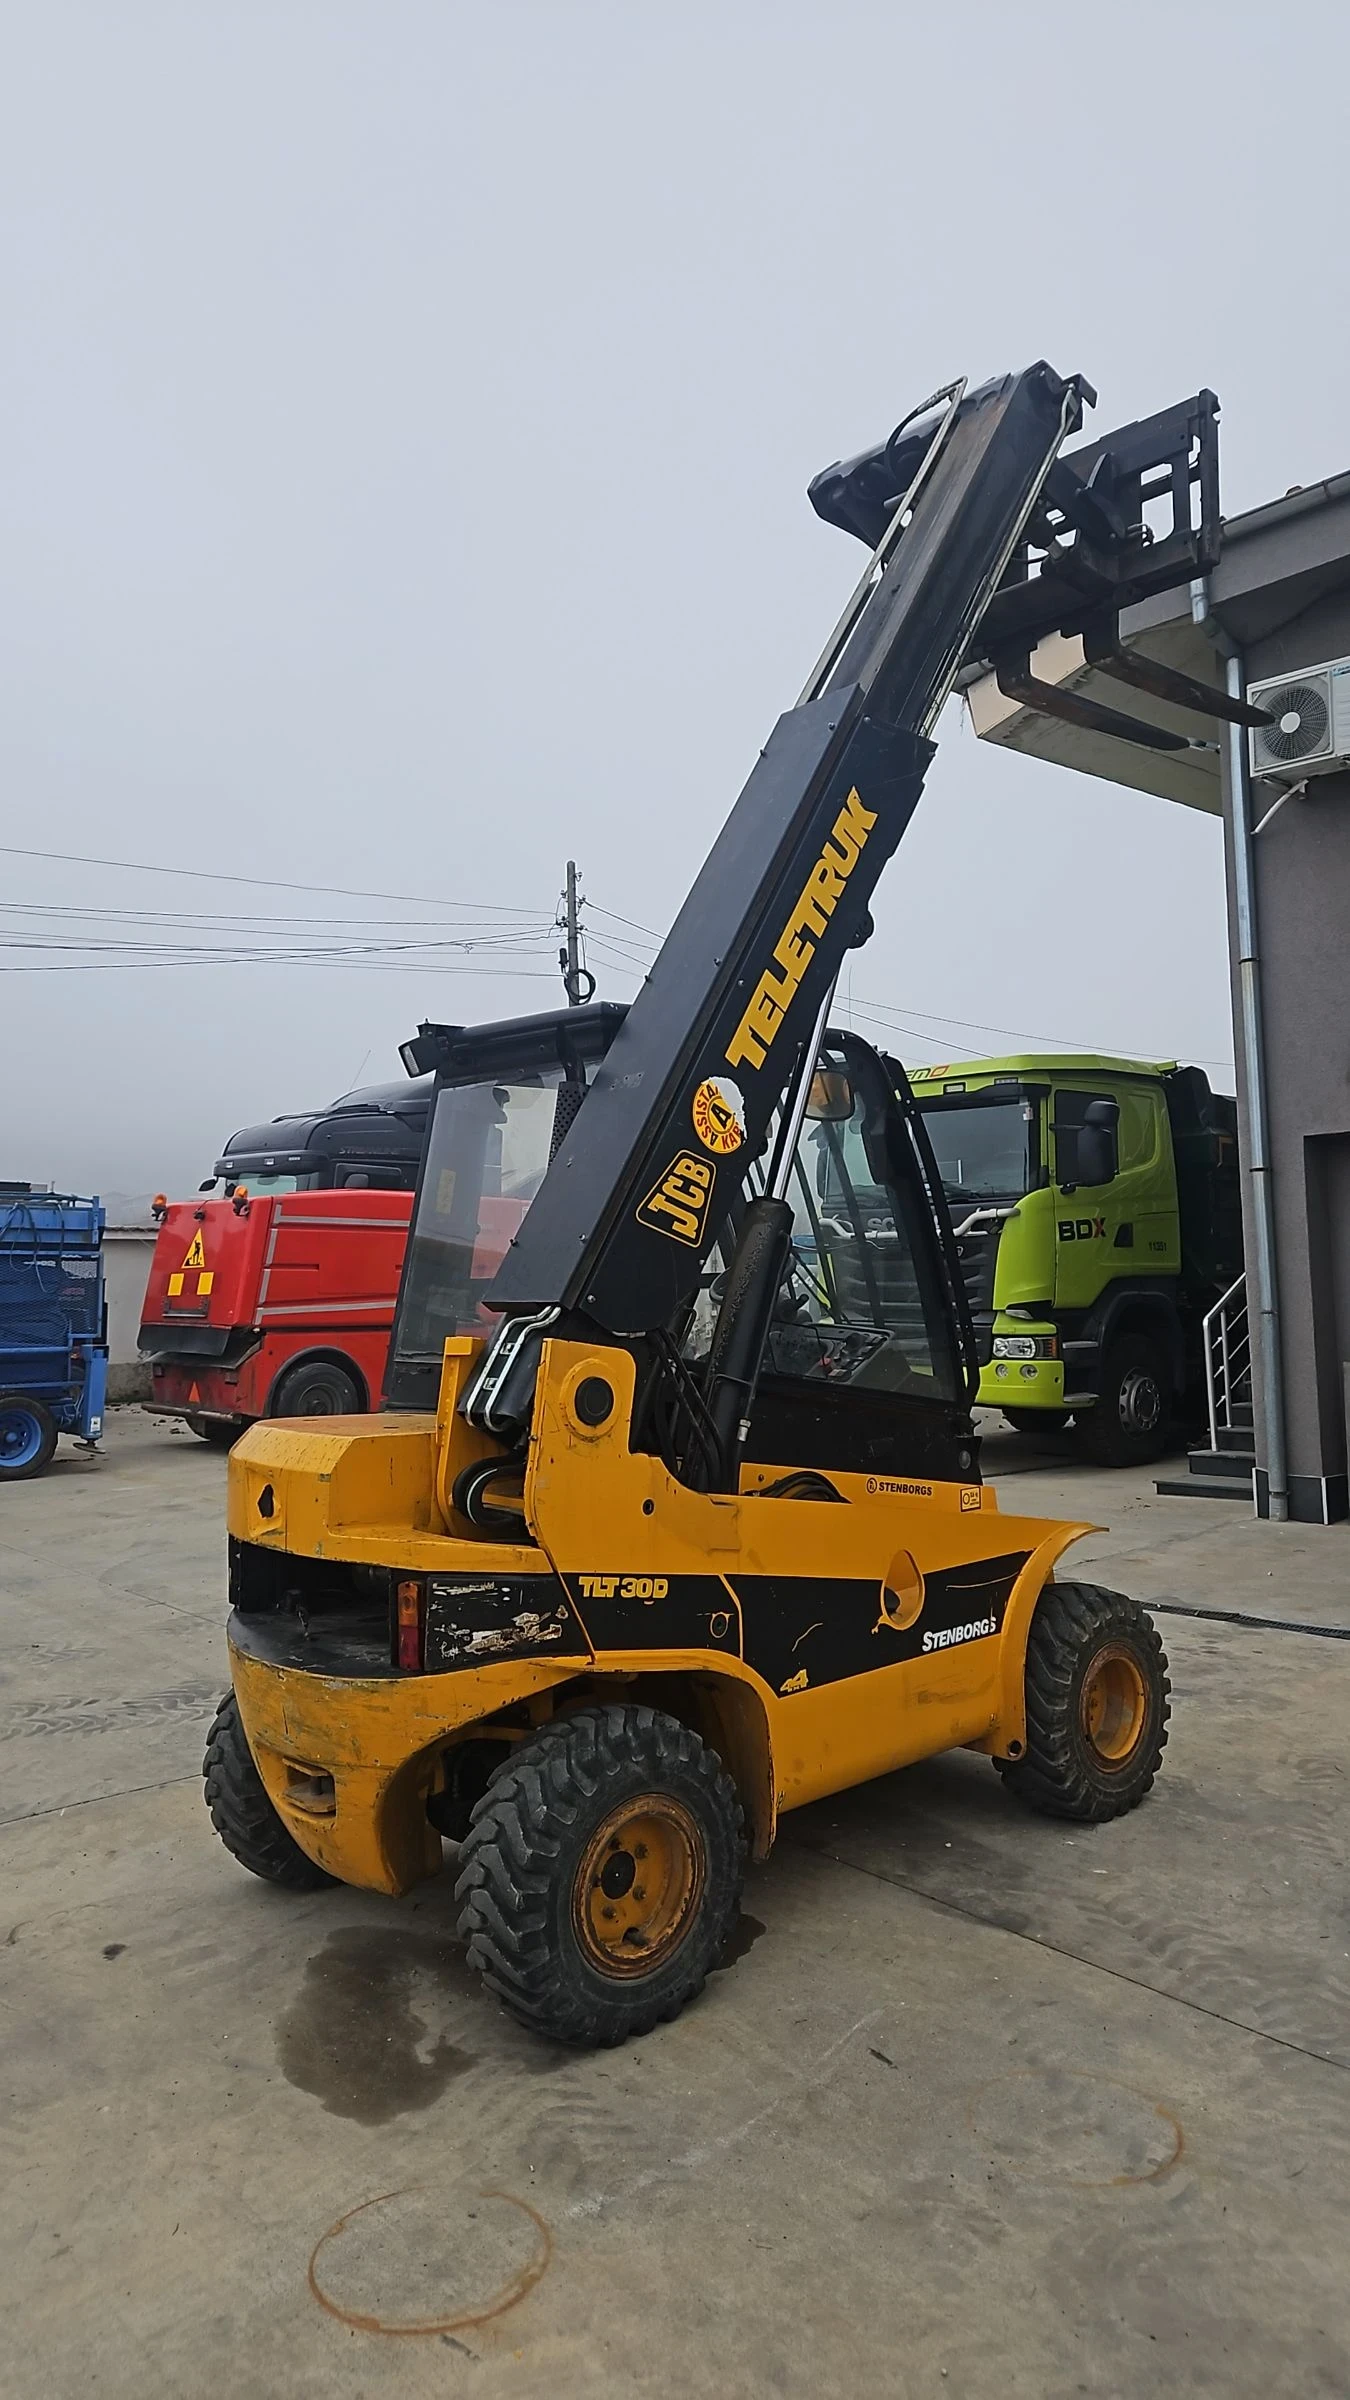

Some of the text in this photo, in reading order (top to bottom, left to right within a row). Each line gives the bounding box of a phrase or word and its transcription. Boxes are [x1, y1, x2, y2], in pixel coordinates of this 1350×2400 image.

[724, 785, 879, 1071] TELETRUK
[695, 1083, 719, 1146] ASSISTA
[647, 1158, 711, 1240] JCB
[1058, 1216, 1107, 1242] BDX
[878, 1481, 933, 1496] STENBORGS
[578, 1576, 620, 1598] TLT
[922, 1616, 997, 1652] STENBORGS
